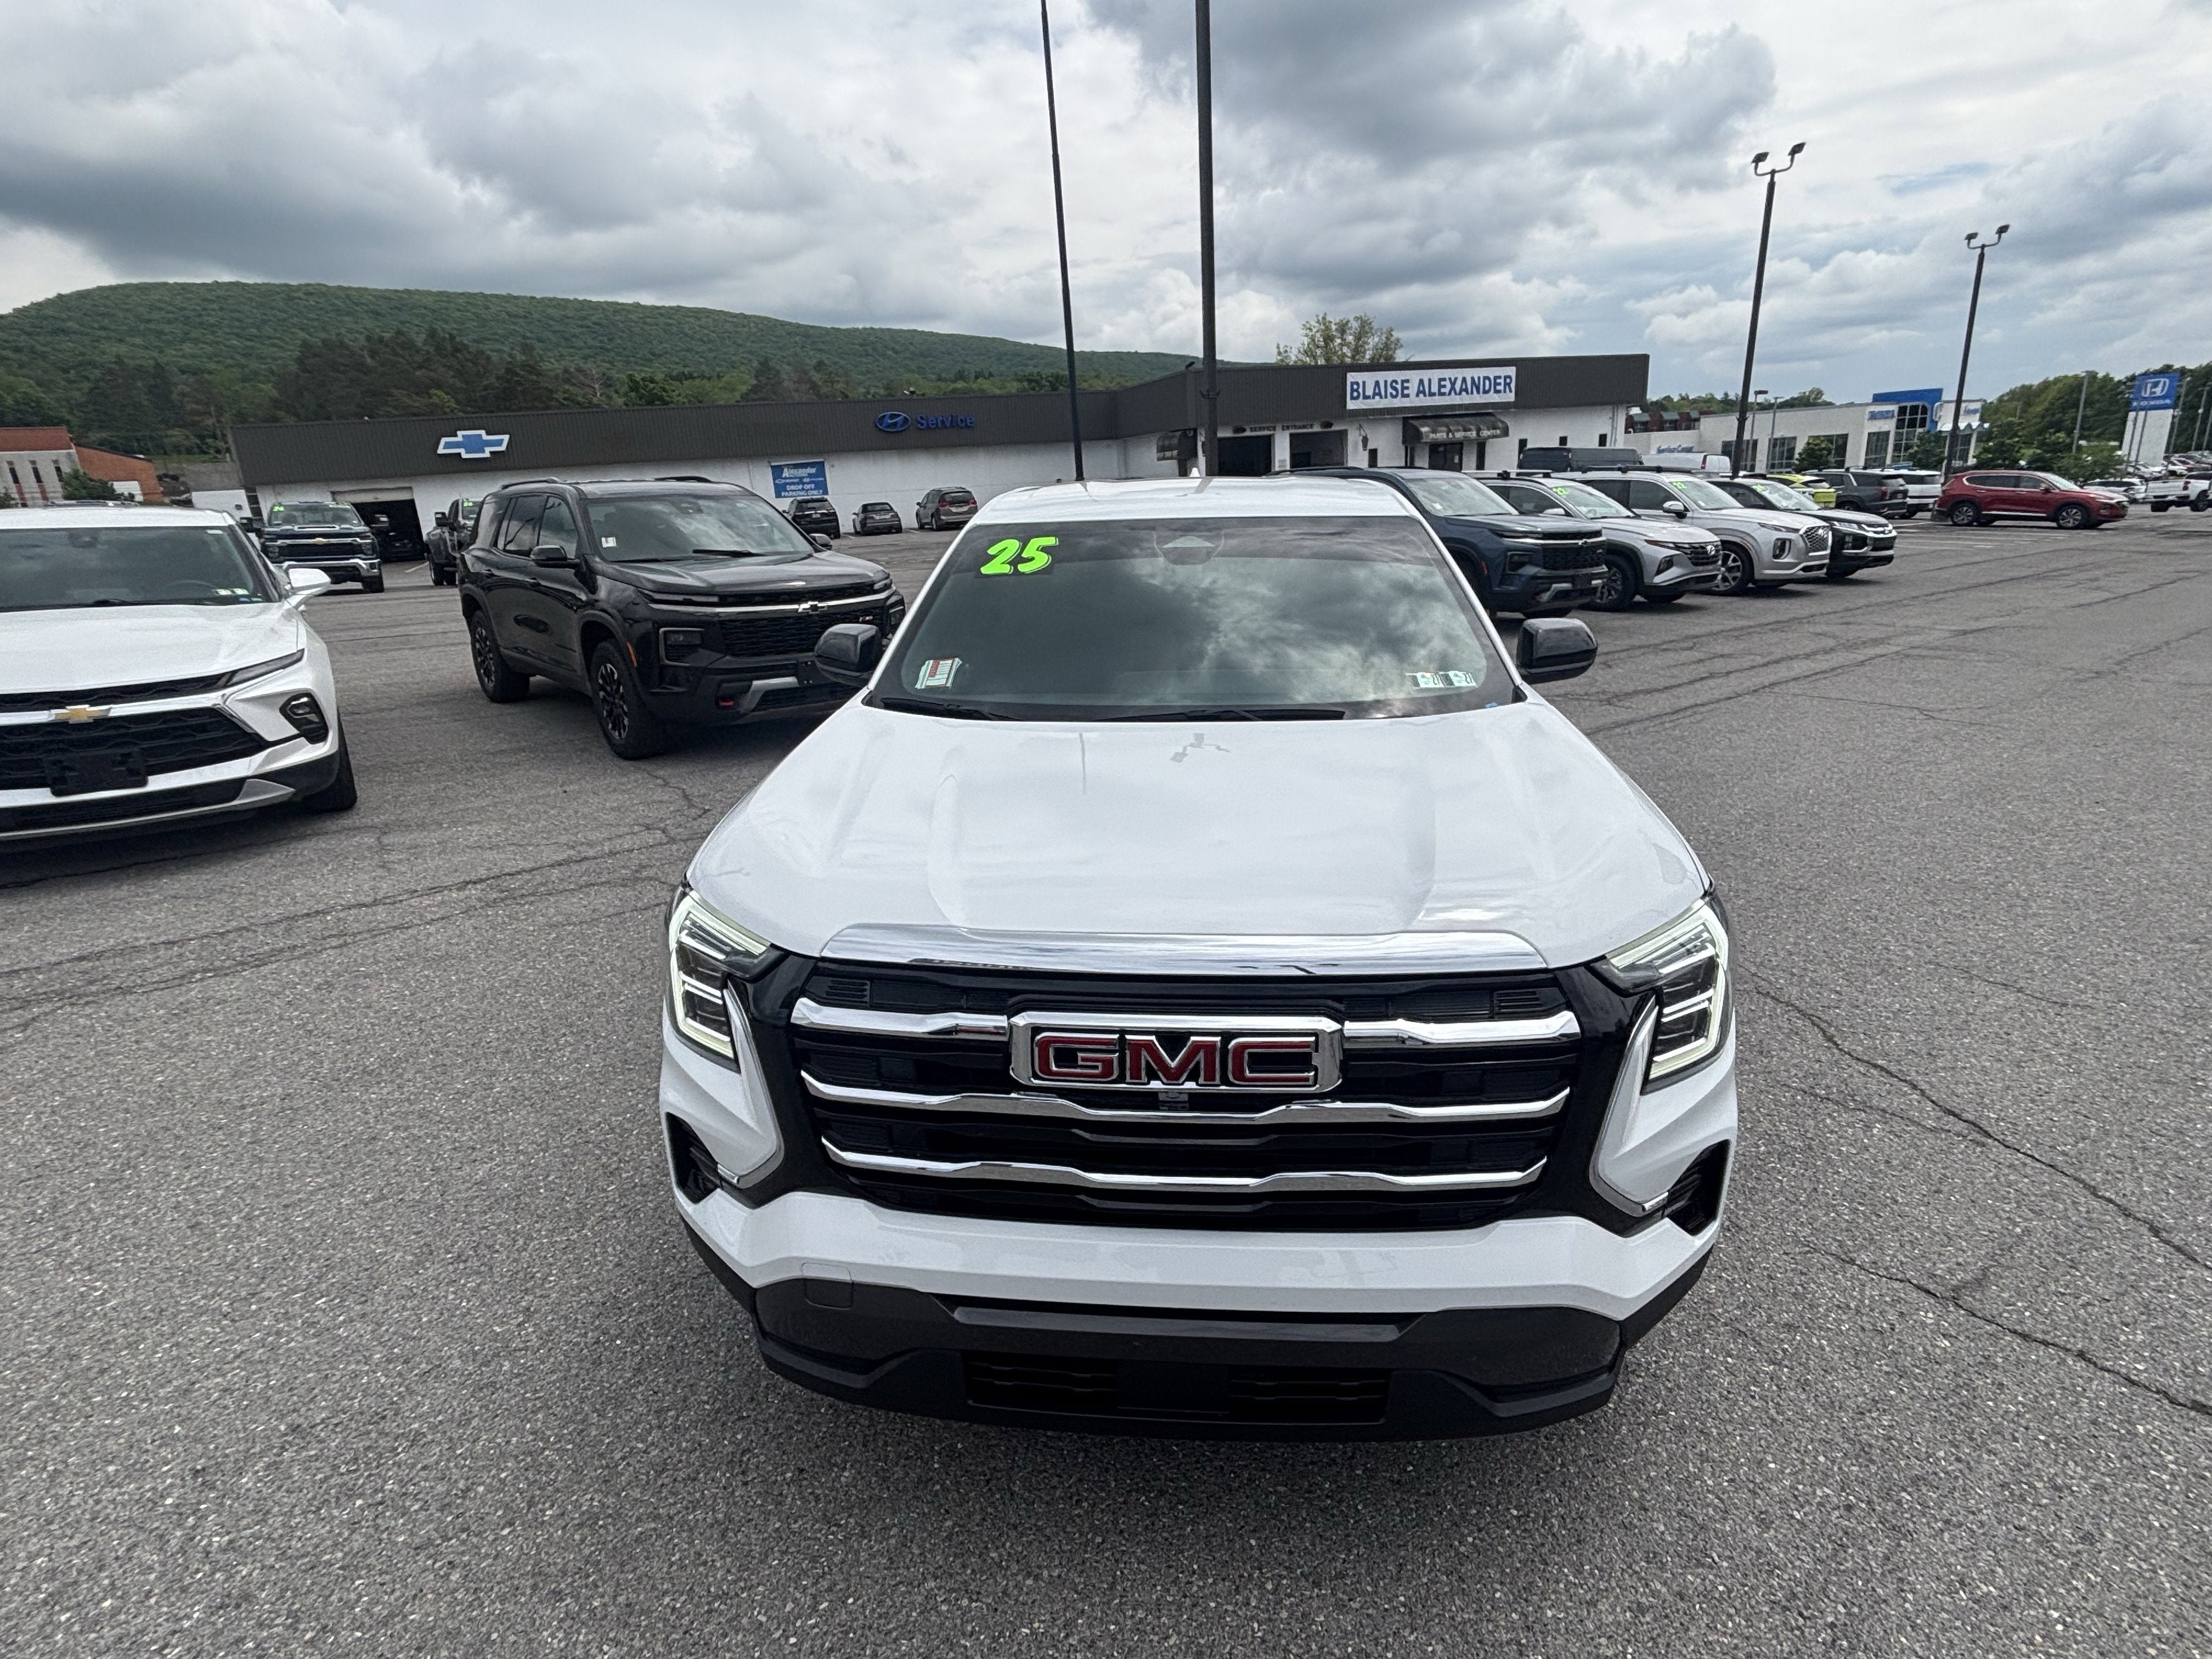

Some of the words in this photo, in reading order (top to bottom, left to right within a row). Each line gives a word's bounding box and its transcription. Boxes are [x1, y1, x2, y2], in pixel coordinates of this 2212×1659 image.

[1350, 379, 1410, 400] BLAISE
[1415, 375, 1513, 398] ALEXANDER
[1282, 423, 1315, 431] ENTRANCE
[980, 537, 1059, 574] 25
[1034, 1032, 1317, 1086] GMC
